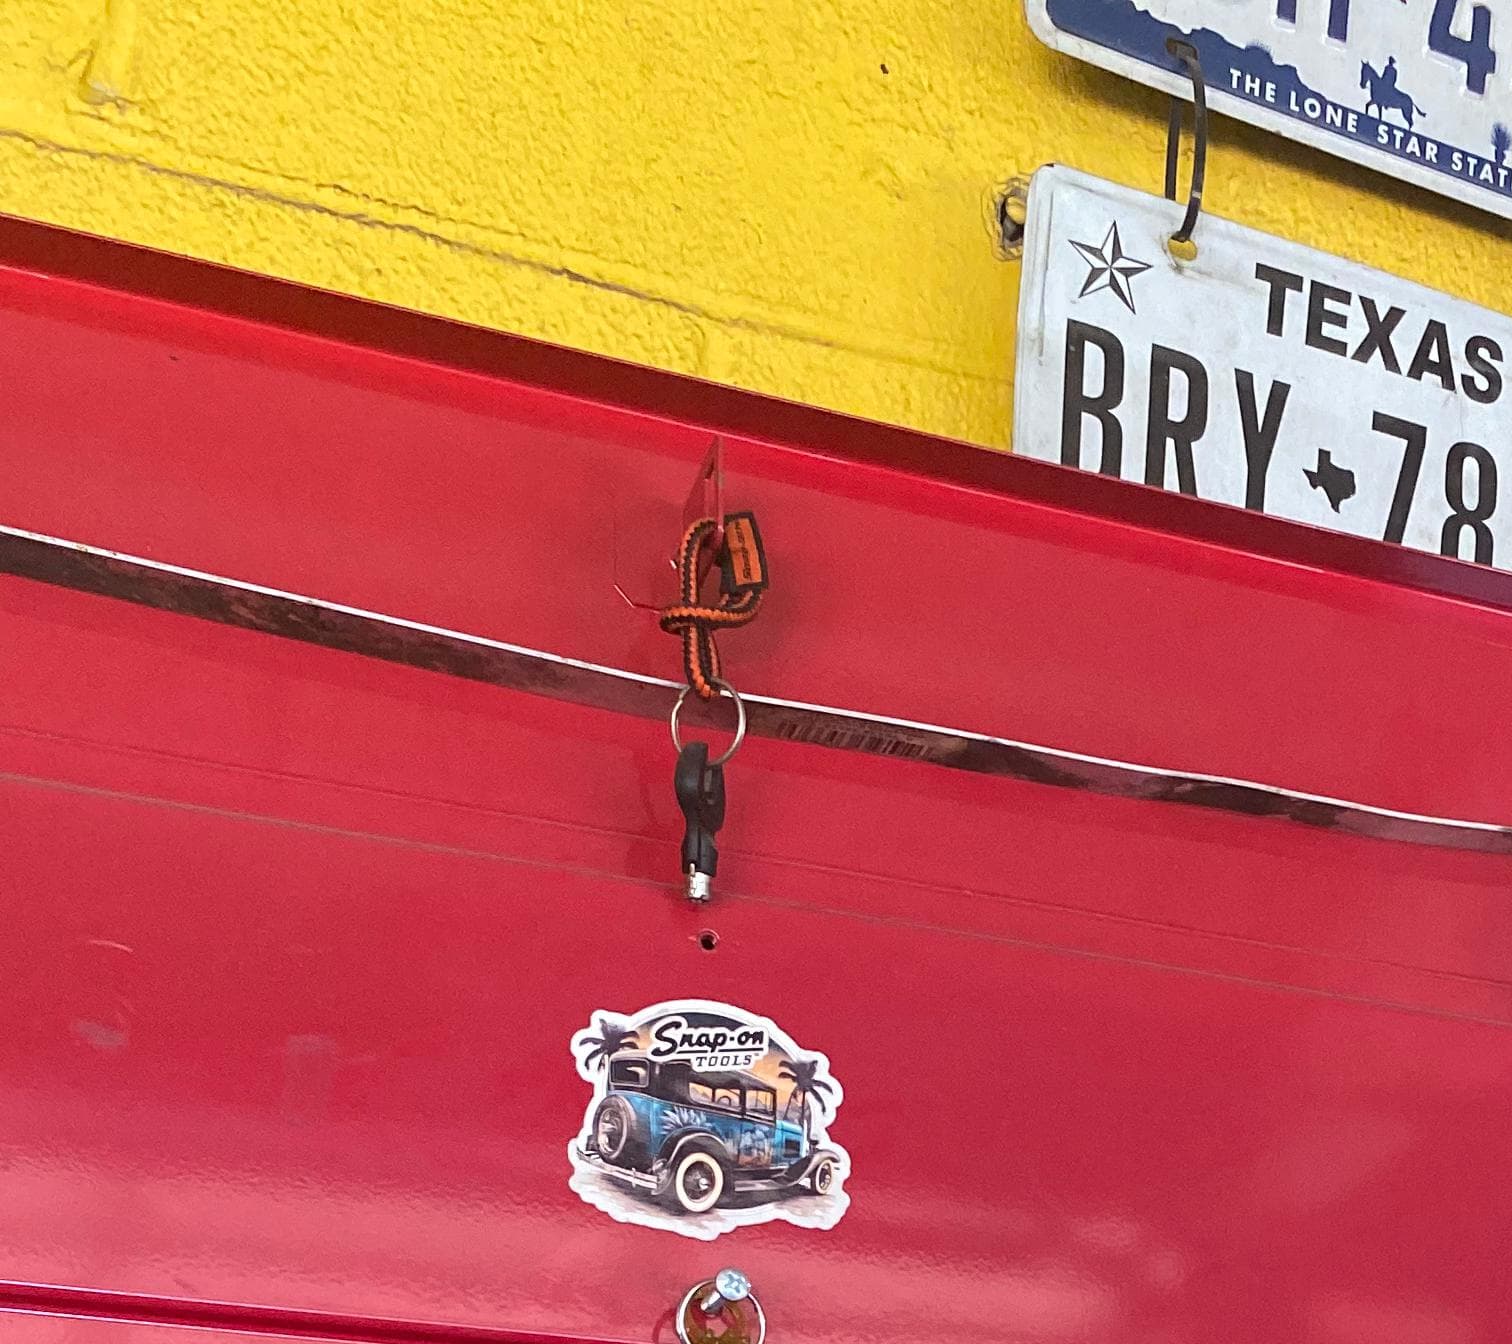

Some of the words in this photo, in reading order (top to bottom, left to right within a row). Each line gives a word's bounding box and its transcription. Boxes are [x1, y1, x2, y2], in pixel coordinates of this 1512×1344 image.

[1229, 68, 1278, 103] THE
[1290, 84, 1359, 133] LONE
[1378, 125, 1438, 164] STAR
[1255, 262, 1504, 404] TEXAS
[650, 1016, 765, 1057] Snap-on
[695, 1055, 751, 1068] TOOLS
